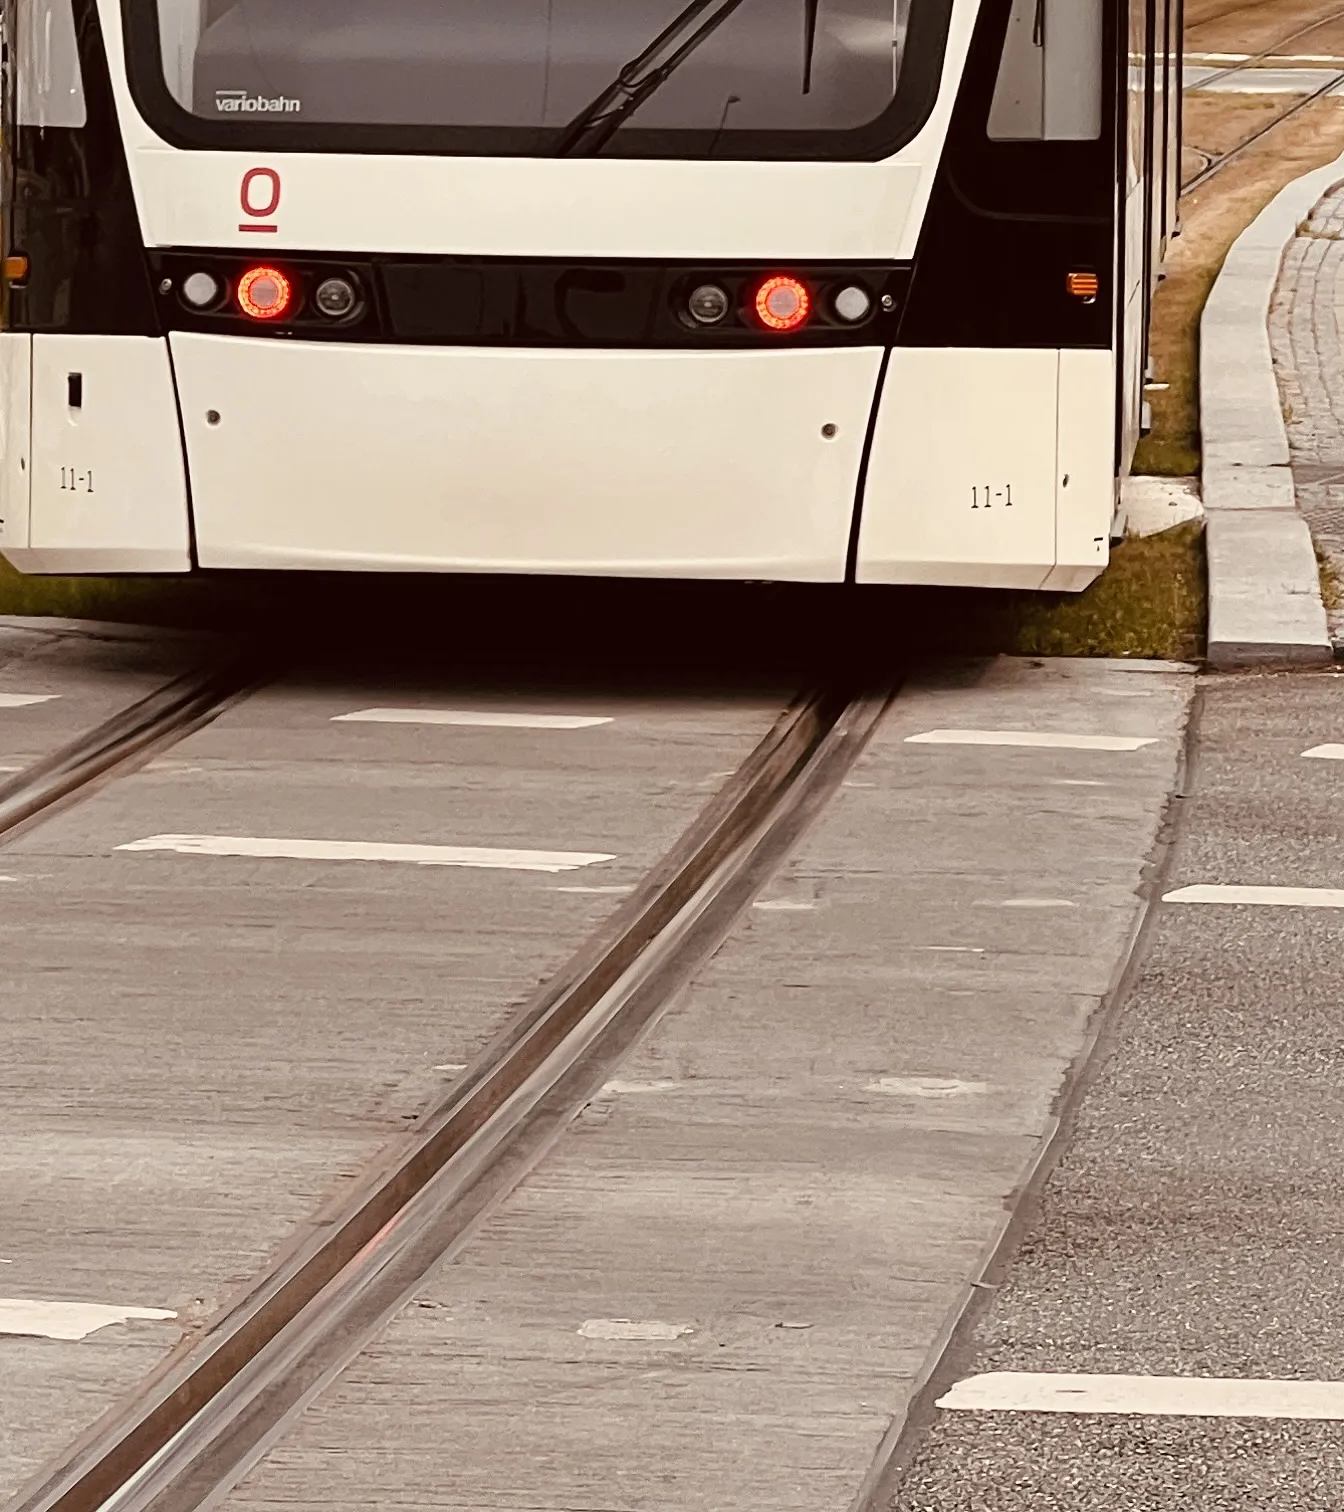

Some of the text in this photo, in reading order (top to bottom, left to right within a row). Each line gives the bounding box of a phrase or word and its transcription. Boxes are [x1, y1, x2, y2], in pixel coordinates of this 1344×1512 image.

[215, 95, 301, 112] variobahn
[60, 466, 94, 493] 11-1
[970, 483, 1013, 509] 11-1
